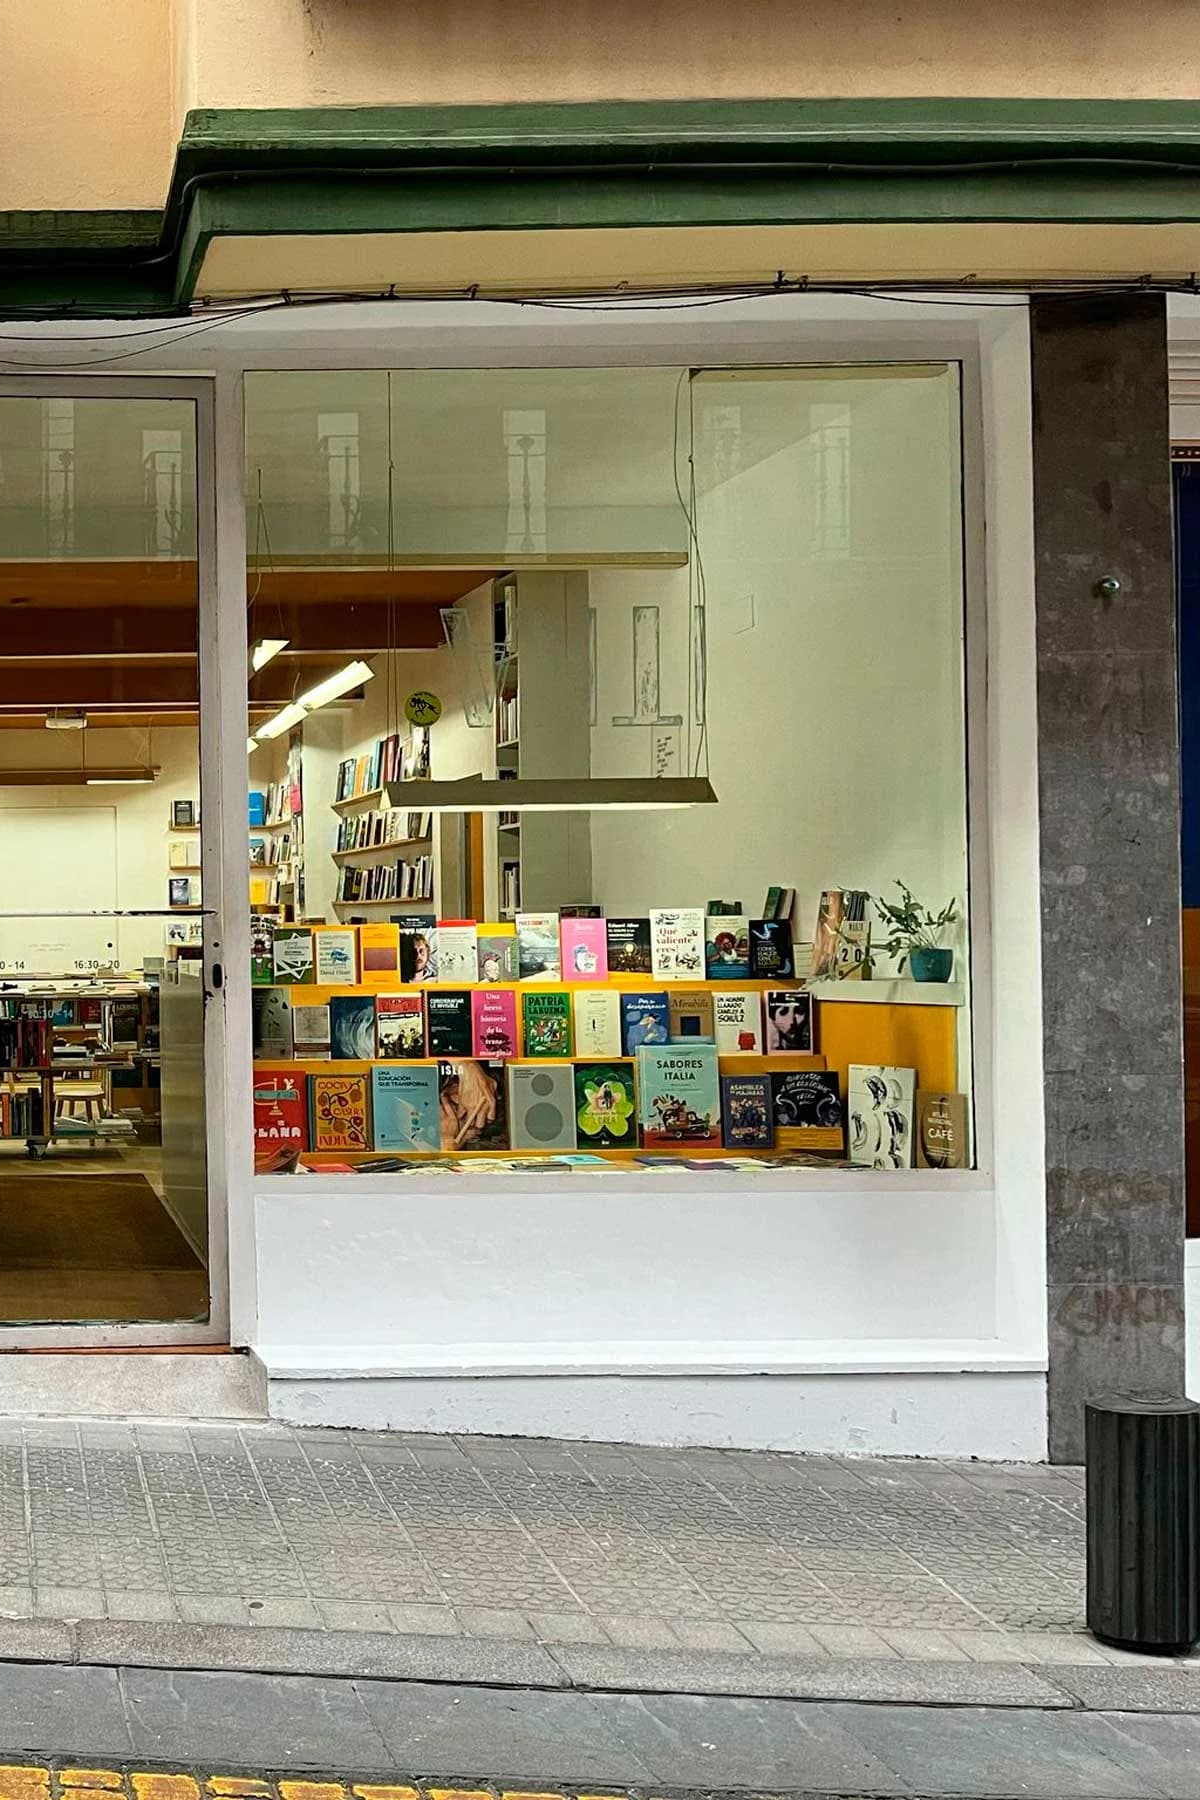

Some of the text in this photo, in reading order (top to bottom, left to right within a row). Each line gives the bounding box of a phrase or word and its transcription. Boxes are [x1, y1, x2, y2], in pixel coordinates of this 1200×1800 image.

[15, 961, 25, 970] 14
[74, 960, 99, 969] 16:30
[108, 960, 120, 969] 20
[528, 996, 565, 1006] PATRIA
[656, 1060, 703, 1069] SABORES
[441, 1065, 464, 1076] ISLA
[664, 1072, 696, 1080] ITALIA
[928, 1127, 953, 1141] CAFÉ
